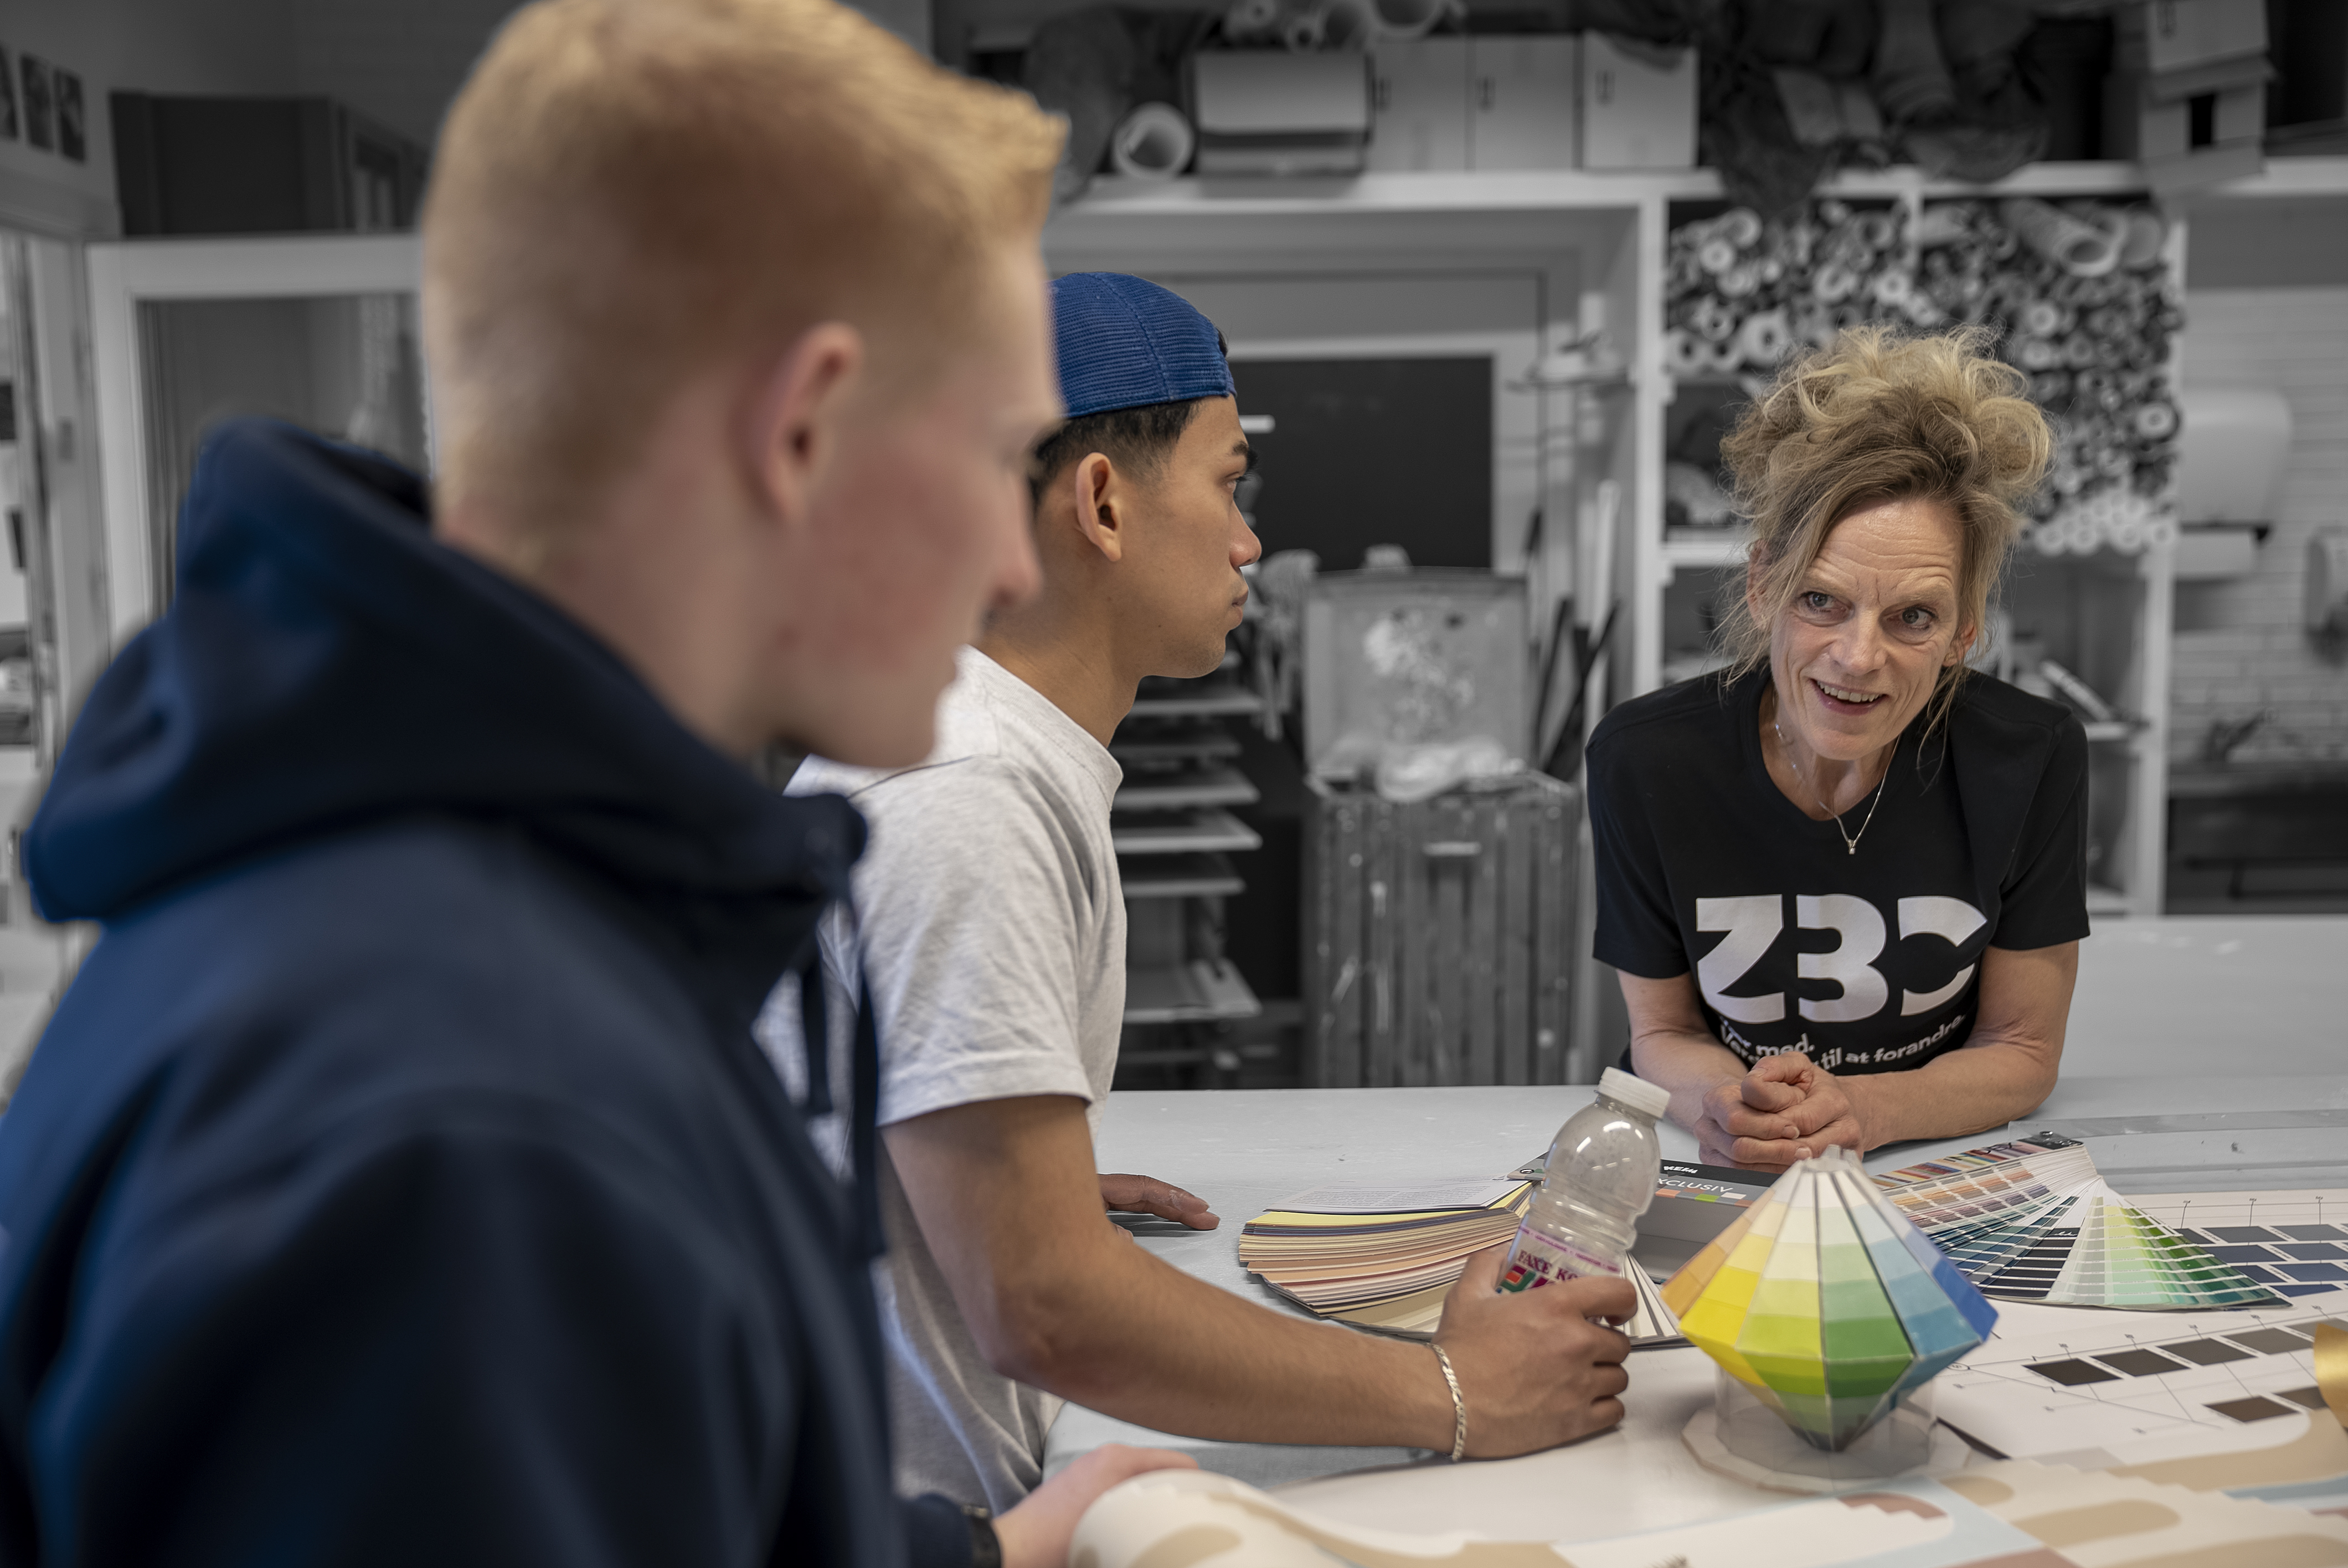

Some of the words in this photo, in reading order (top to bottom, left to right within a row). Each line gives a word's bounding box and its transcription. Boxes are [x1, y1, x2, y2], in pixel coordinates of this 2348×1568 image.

[1821, 1047, 1842, 1070] til
[1845, 1052, 1870, 1064] at
[1663, 1165, 1698, 1174] KEIM
[1657, 1178, 1733, 1192] XCLUSIV
[1517, 1244, 1552, 1274] FAXE
